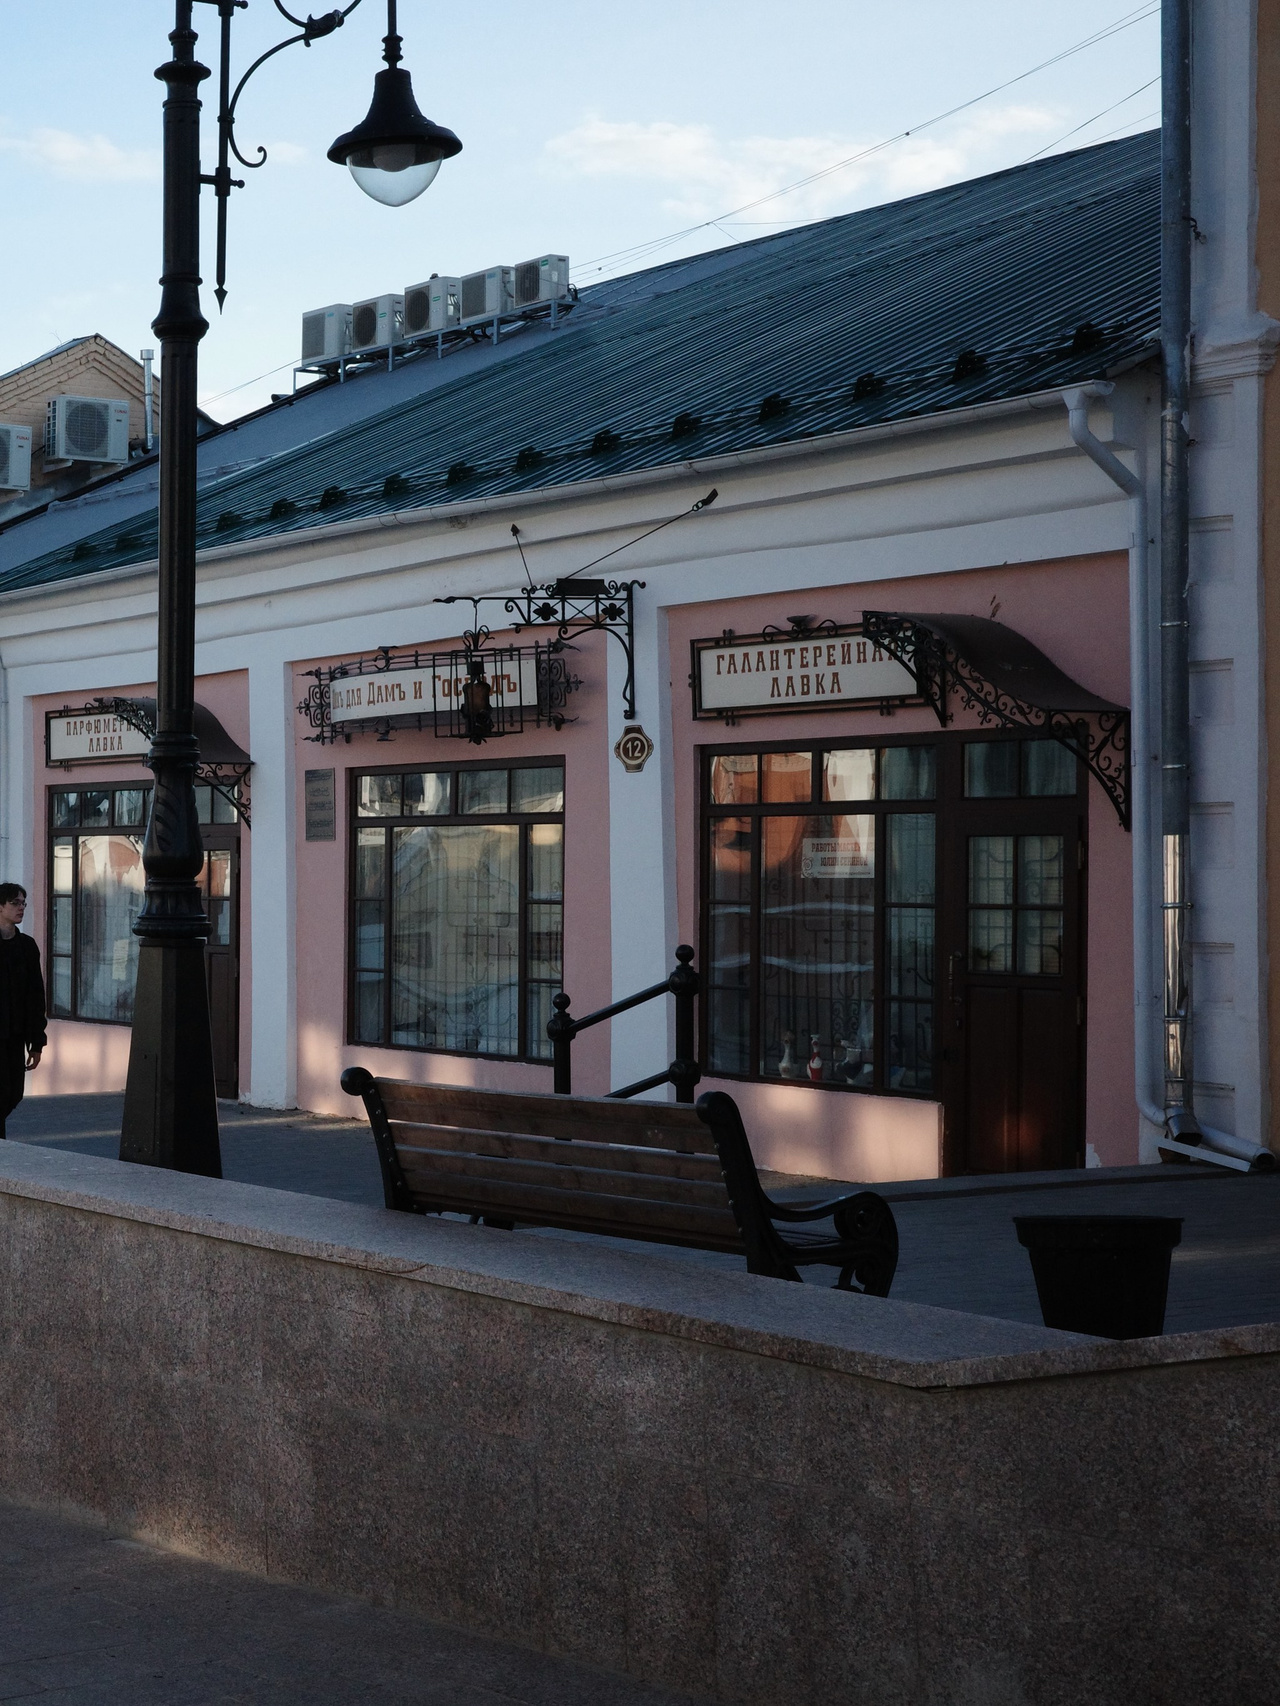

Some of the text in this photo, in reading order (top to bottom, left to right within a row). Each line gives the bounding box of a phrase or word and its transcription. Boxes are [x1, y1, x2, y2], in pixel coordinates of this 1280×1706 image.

[431, 673, 517, 698] Госдъ
[770, 672, 842, 698] ЛАВКА
[88, 735, 123, 753] ЛАВКА
[626, 740, 642, 757] 12
[811, 842, 837, 852] РАБОТЫ
